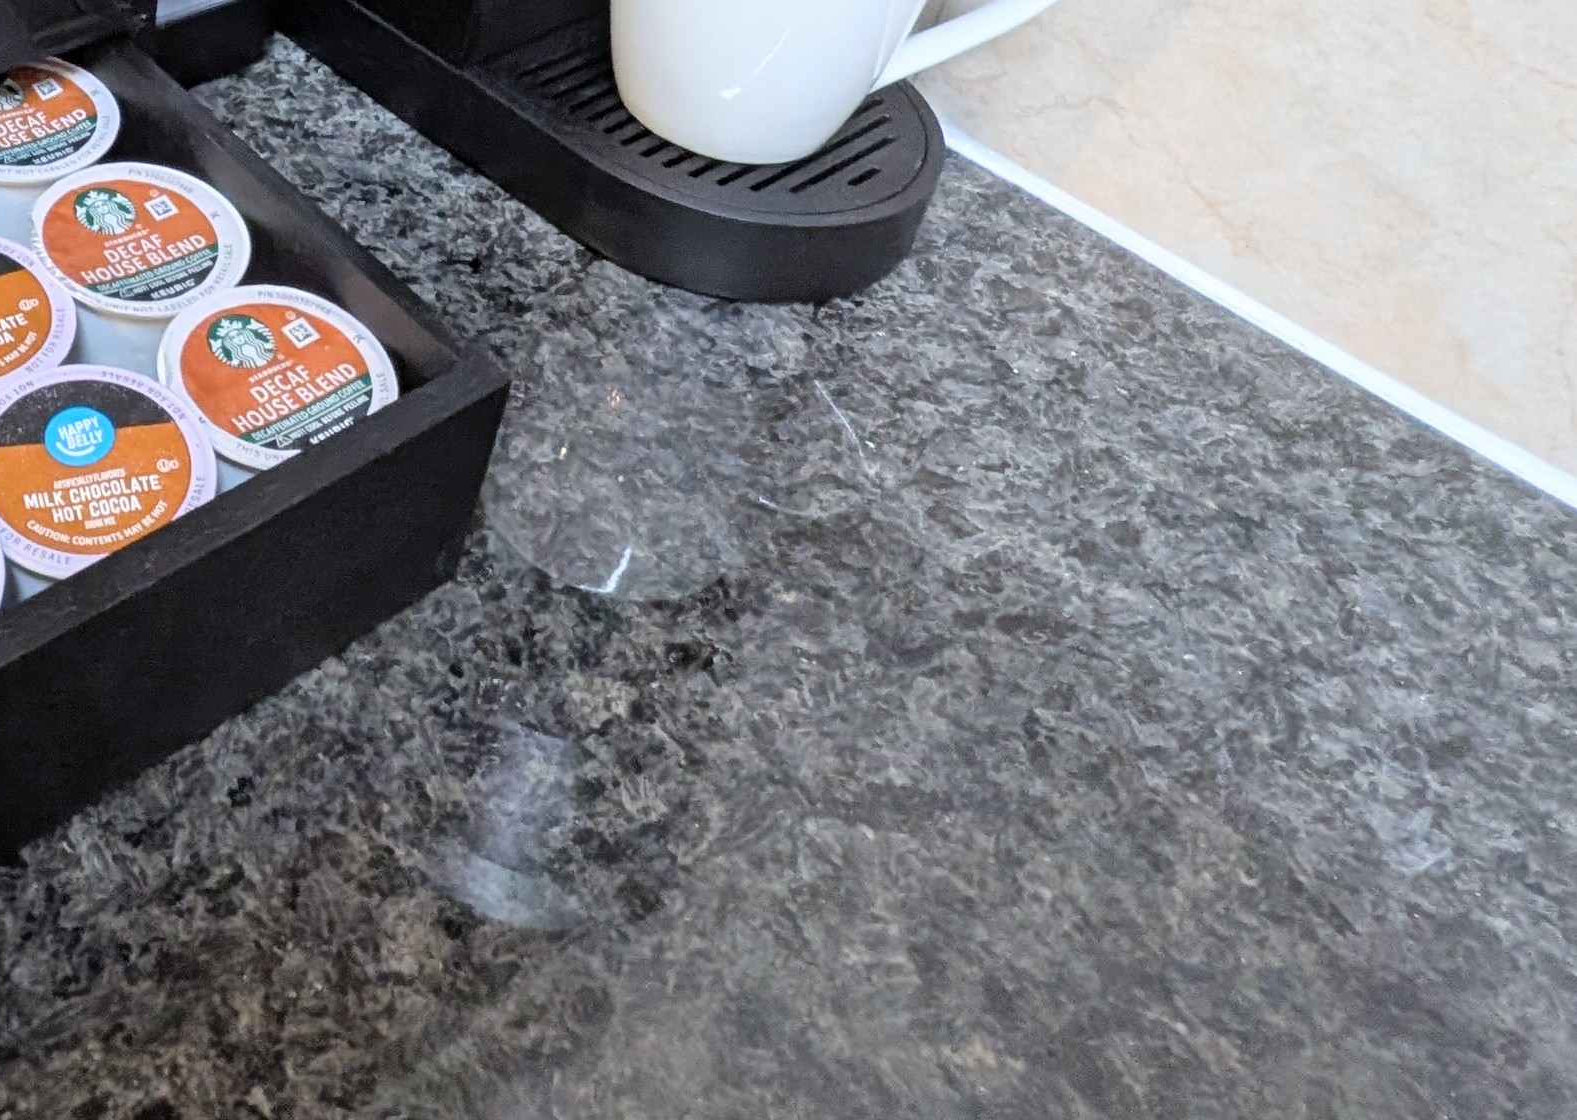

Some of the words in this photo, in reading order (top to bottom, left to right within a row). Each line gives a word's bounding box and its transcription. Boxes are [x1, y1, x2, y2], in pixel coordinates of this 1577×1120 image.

[31, 108, 87, 138] BLEND
[81, 258, 147, 284] HOUSE
[146, 234, 206, 265] BLEND
[104, 234, 162, 263] DECAF
[153, 256, 186, 277] GROUND
[185, 249, 211, 265] COFFEE
[151, 280, 197, 300] KEURIG
[4, 349, 21, 364] MAY
[231, 393, 299, 433] HOUSE
[295, 362, 357, 404] BLEND
[249, 365, 311, 403] DECAF
[252, 407, 309, 441] DECAFFEINATED
[308, 394, 341, 419] GROUND
[337, 381, 365, 402] COFFEE
[58, 416, 100, 439] HAPPY
[67, 430, 103, 449] BELLY
[23, 489, 64, 509] MILK
[69, 474, 161, 502] CHOCOLATE
[27, 520, 70, 544] CAUTION:
[72, 532, 123, 546] CONTENTS
[124, 524, 142, 538] MAY
[142, 517, 154, 527] BE
[152, 500, 168, 520] HOT
[52, 504, 83, 523] HOT
[89, 495, 142, 517] COCOA
[1, 525, 20, 545] FOR
[24, 544, 71, 565] RESALE
